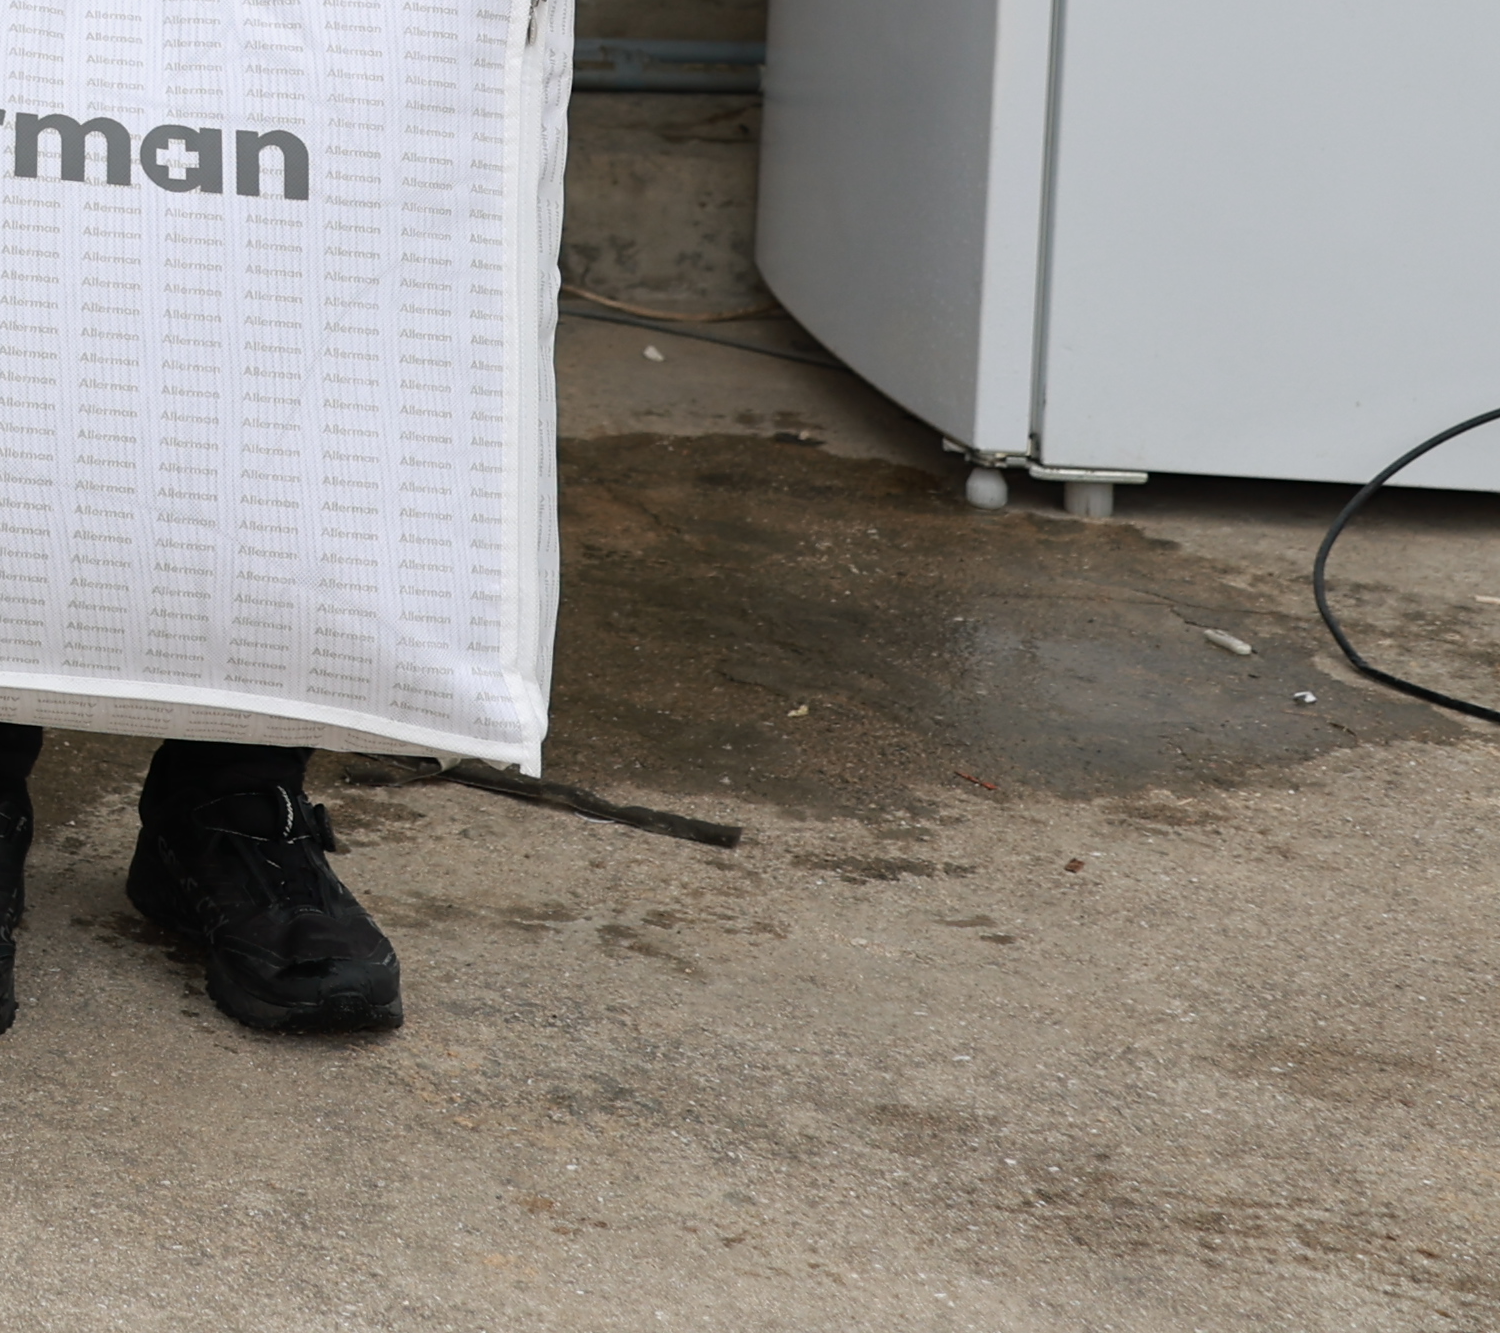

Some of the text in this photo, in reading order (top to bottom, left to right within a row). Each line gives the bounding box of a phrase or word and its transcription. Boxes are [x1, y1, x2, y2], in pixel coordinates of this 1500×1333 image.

[402, 0, 460, 16] Allerman
[8, 70, 65, 86] Allerman
[326, 67, 385, 83] Allerman
[165, 85, 224, 97] Allerman
[400, 151, 454, 167] Allerman
[83, 201, 143, 216] Allerman
[245, 214, 303, 228] Allerman
[0, 243, 61, 260] Allerman
[399, 251, 453, 268] Allerman
[161, 332, 223, 349] Allerman
[323, 346, 380, 363] Allerman
[241, 391, 302, 408] Allerman
[158, 436, 220, 452] Allerman
[399, 455, 453, 470] Allerman
[73, 479, 137, 495] Allerman
[239, 493, 301, 510] Allerman
[153, 560, 216, 578] Allerman
[397, 558, 454, 573] Allerman
[65, 620, 126, 636] Allerman
[313, 625, 374, 645] Allerman
